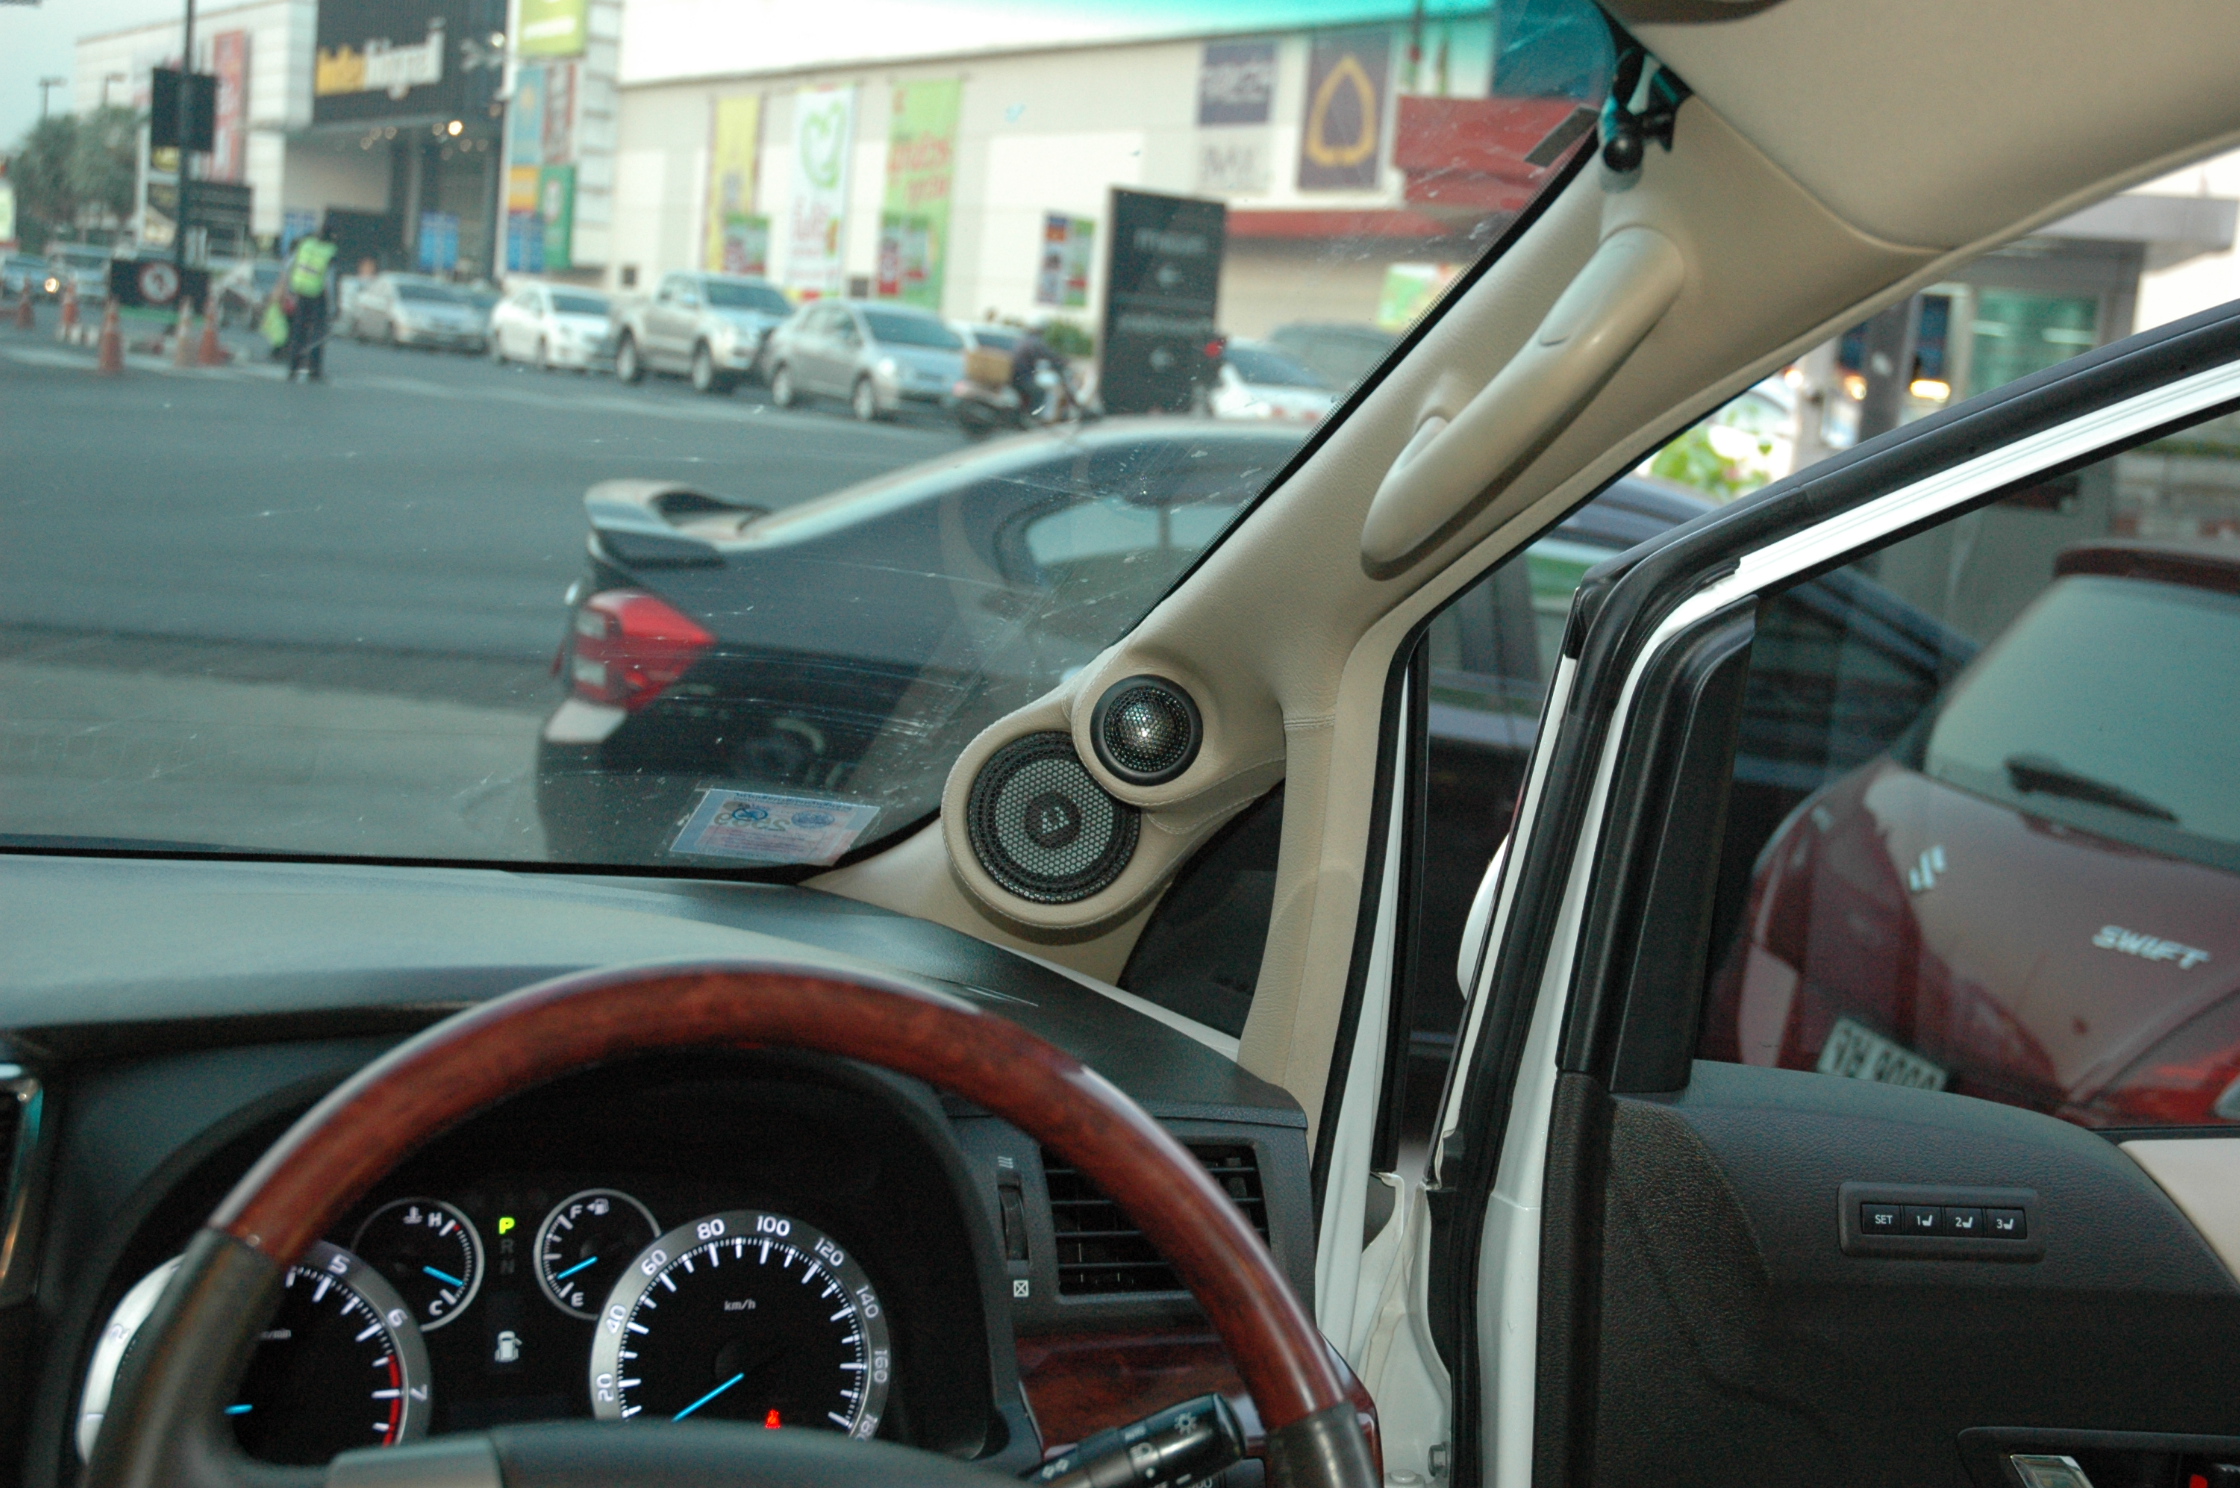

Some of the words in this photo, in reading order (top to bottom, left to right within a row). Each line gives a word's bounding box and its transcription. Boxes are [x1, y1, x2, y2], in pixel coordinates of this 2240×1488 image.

[2092, 925, 2210, 969] SWIFT
[428, 1212, 442, 1227] H
[570, 1205, 583, 1219] F
[1874, 1214, 1894, 1225] SET
[498, 1217, 515, 1235] P
[696, 1218, 725, 1240] 80
[756, 1214, 791, 1237] 100
[1955, 1217, 1963, 1228] 2
[1996, 1218, 2003, 1229] 3
[814, 1236, 845, 1267] 120
[328, 1253, 350, 1275] 5
[641, 1249, 667, 1276] 60
[429, 1300, 443, 1315] C
[571, 1292, 584, 1307] E
[723, 1299, 757, 1312] km/h
[855, 1284, 879, 1319] 140
[387, 1308, 408, 1328] 6
[605, 1304, 627, 1335] 40
[873, 1349, 889, 1384] 160
[409, 1383, 428, 1401] 7
[596, 1372, 614, 1402] 20
